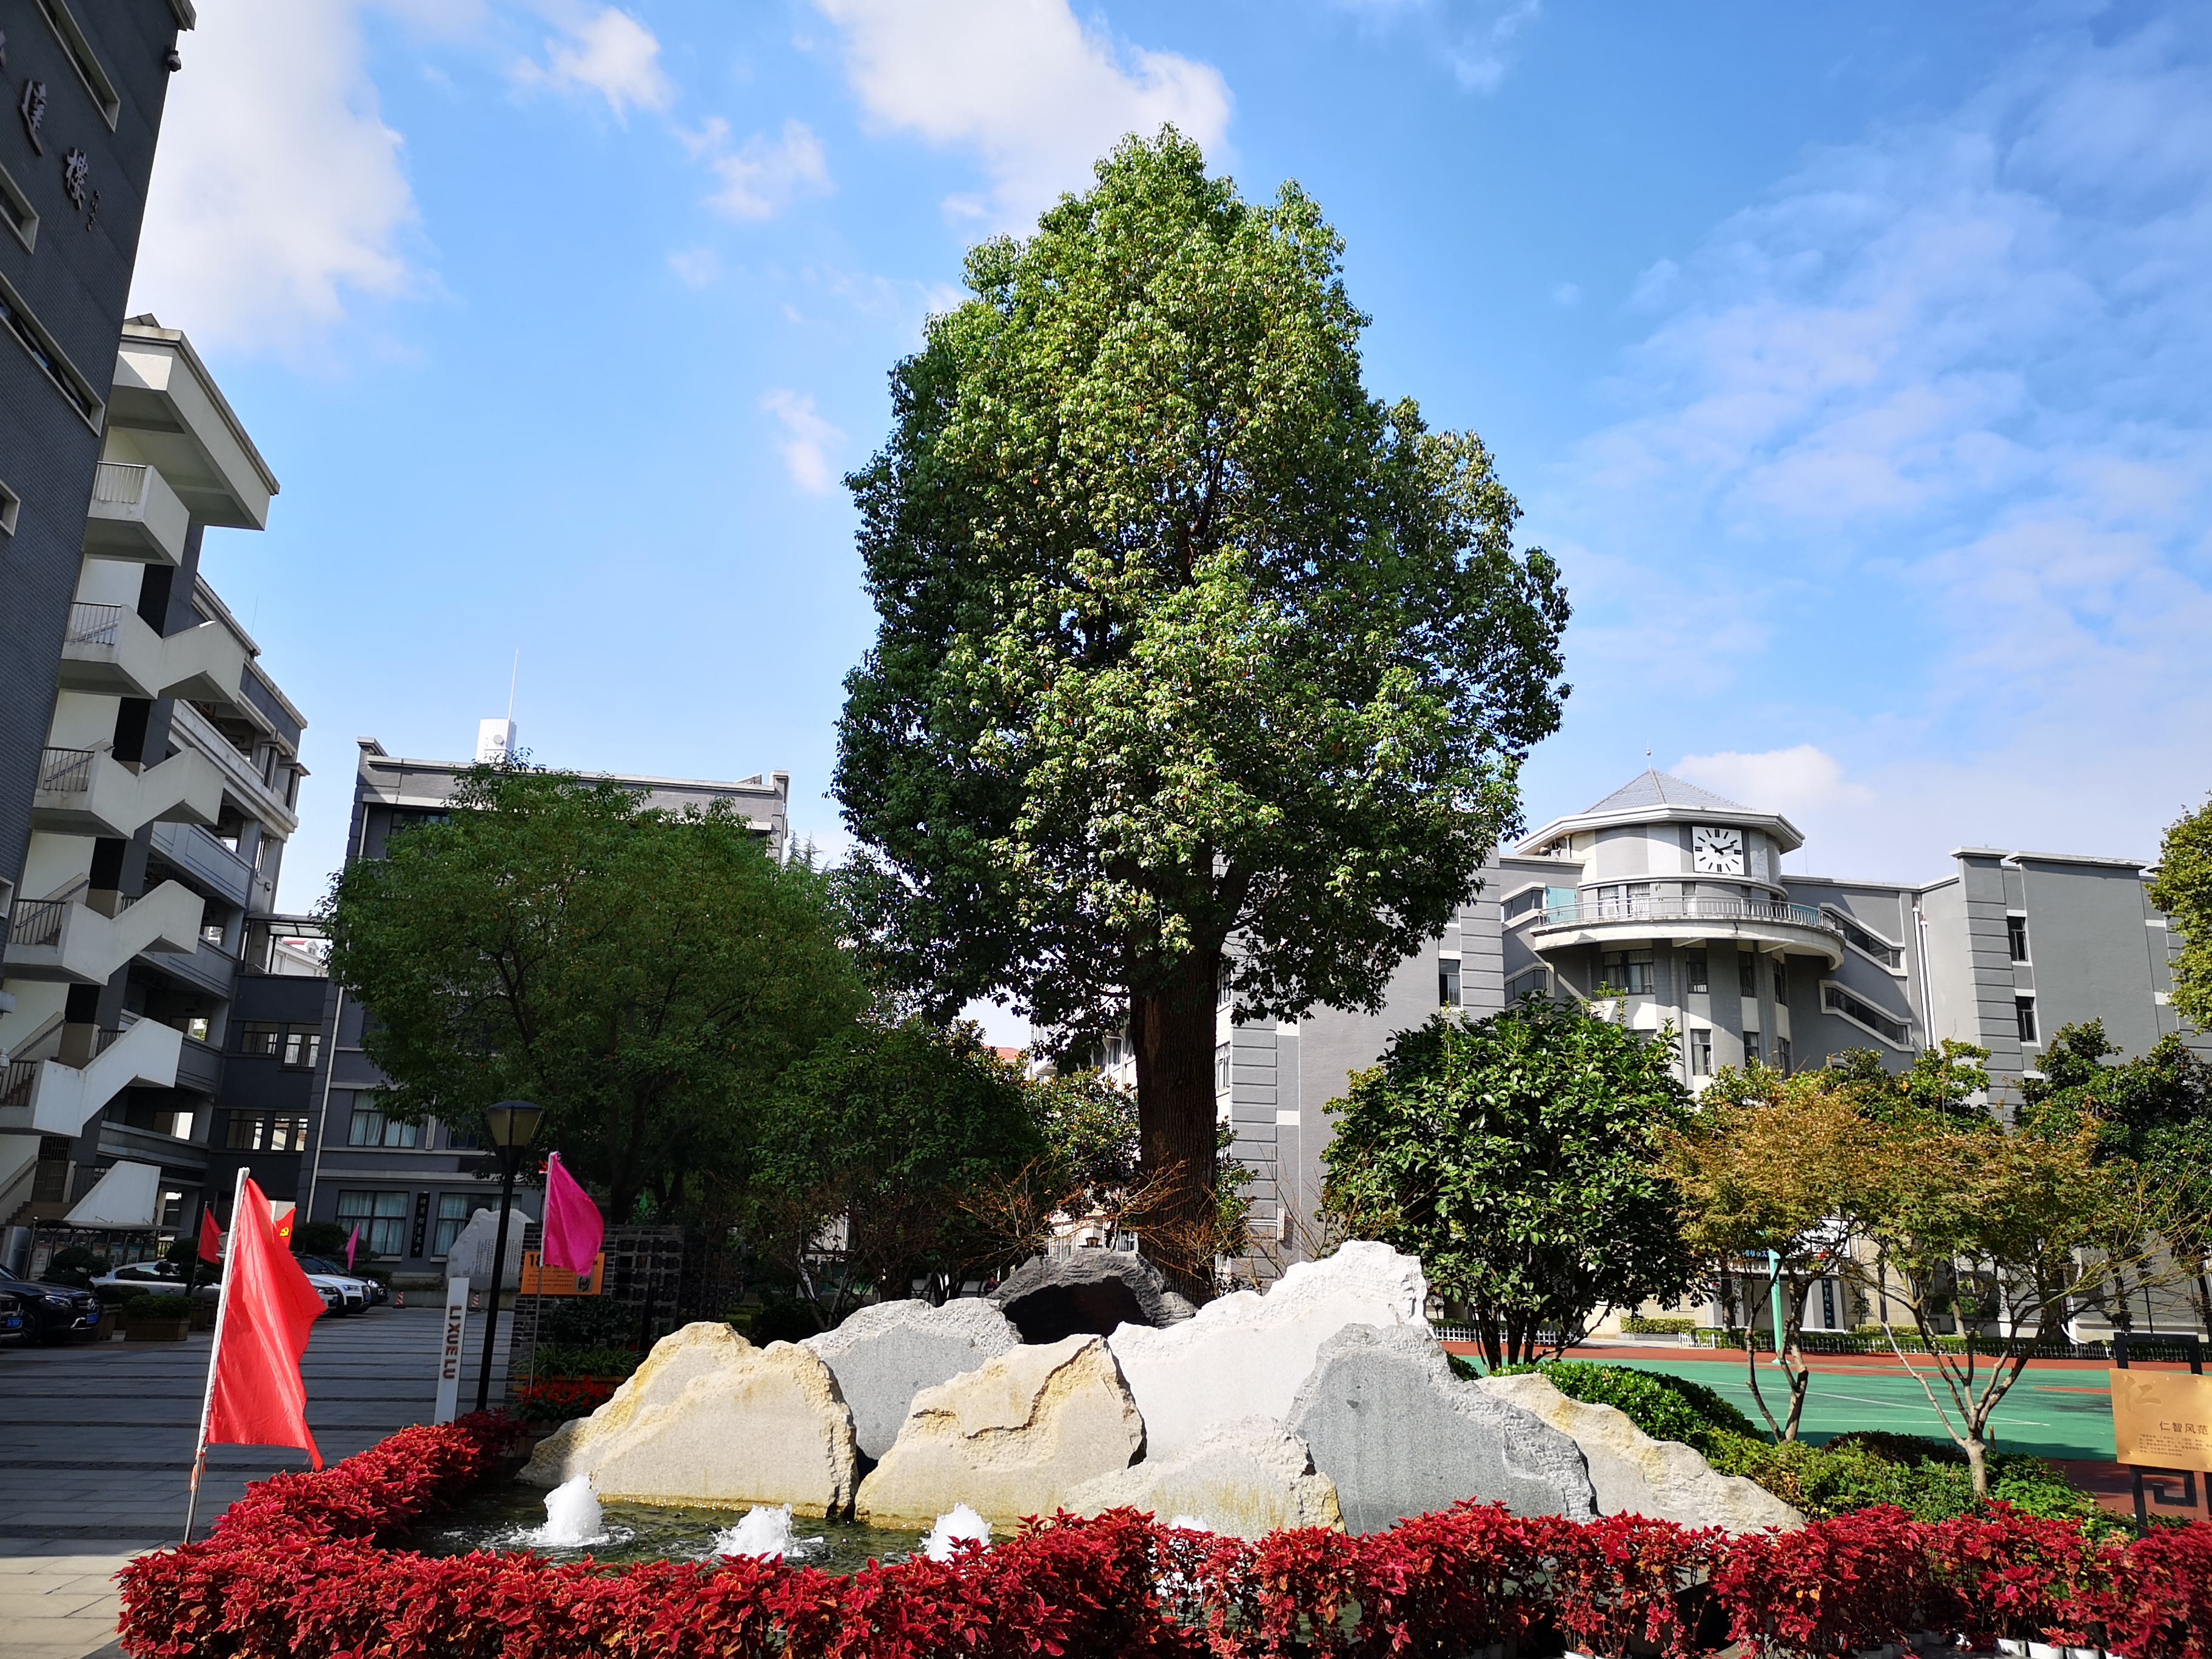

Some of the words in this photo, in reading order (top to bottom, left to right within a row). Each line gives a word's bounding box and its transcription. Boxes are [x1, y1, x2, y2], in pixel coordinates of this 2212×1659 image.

[443, 1305, 462, 1379] LIXUELU
[2117, 1375, 2162, 1412] 仁
[2159, 1421, 2209, 1435] 仁智风范
